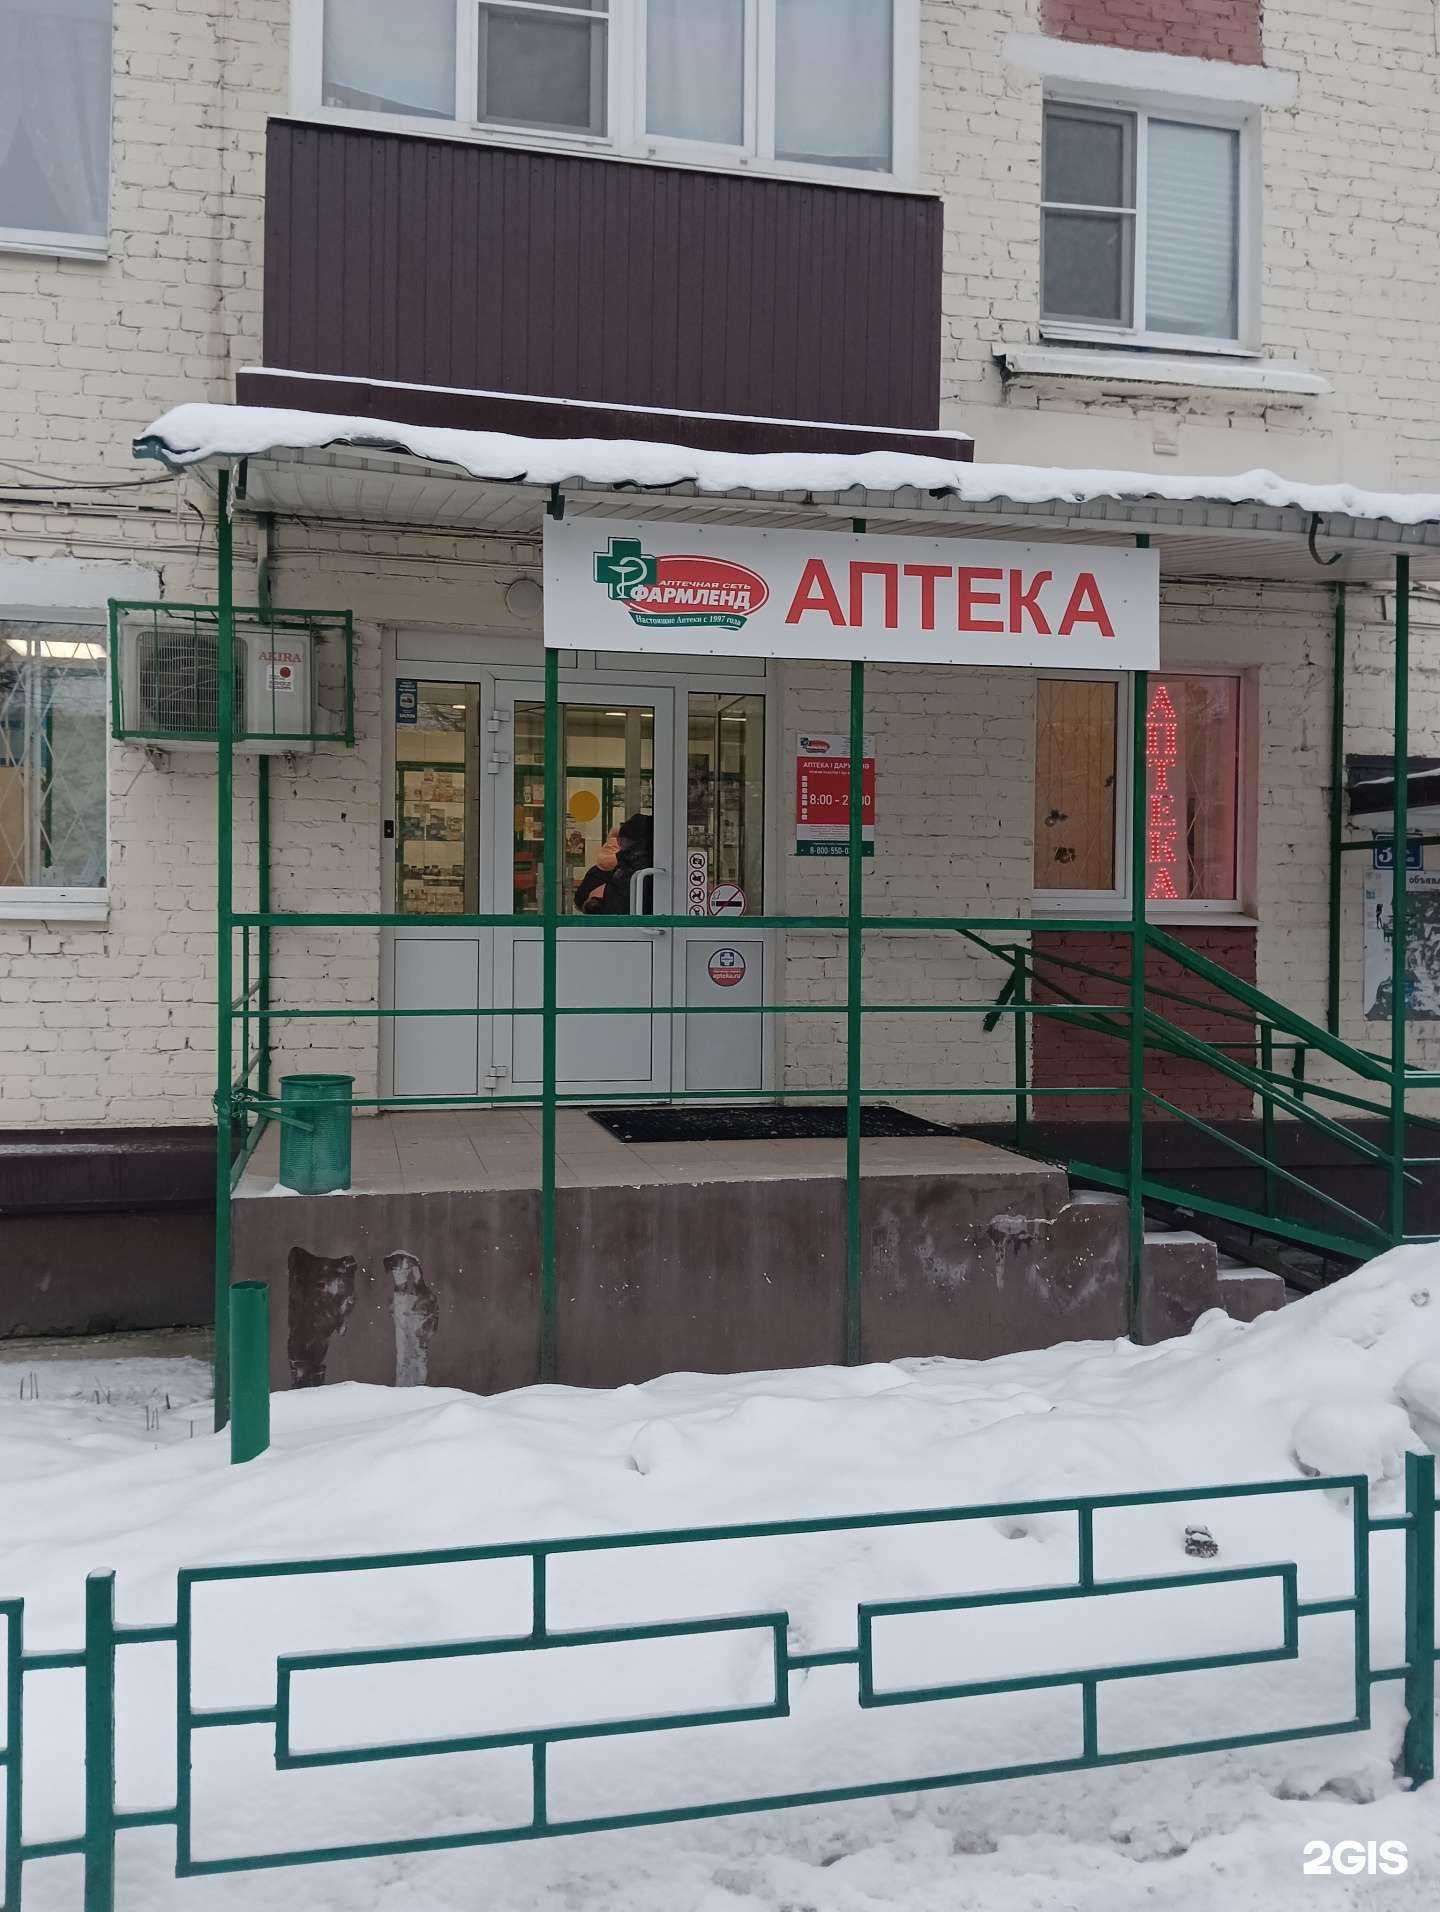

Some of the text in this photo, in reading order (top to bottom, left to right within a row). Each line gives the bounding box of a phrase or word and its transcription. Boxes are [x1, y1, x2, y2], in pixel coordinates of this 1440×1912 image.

[658, 580, 719, 589] АПТЕЧНАЯ
[631, 584, 751, 610] ФАРМЛЕНД
[785, 558, 1116, 637] АПТЕКА
[709, 615, 726, 623] 1997
[258, 651, 303, 663] AKIRA
[802, 761, 830, 769] АПТЕКА
[1146, 686, 1179, 899] АПТЕКА
[809, 794, 833, 806] 8:00
